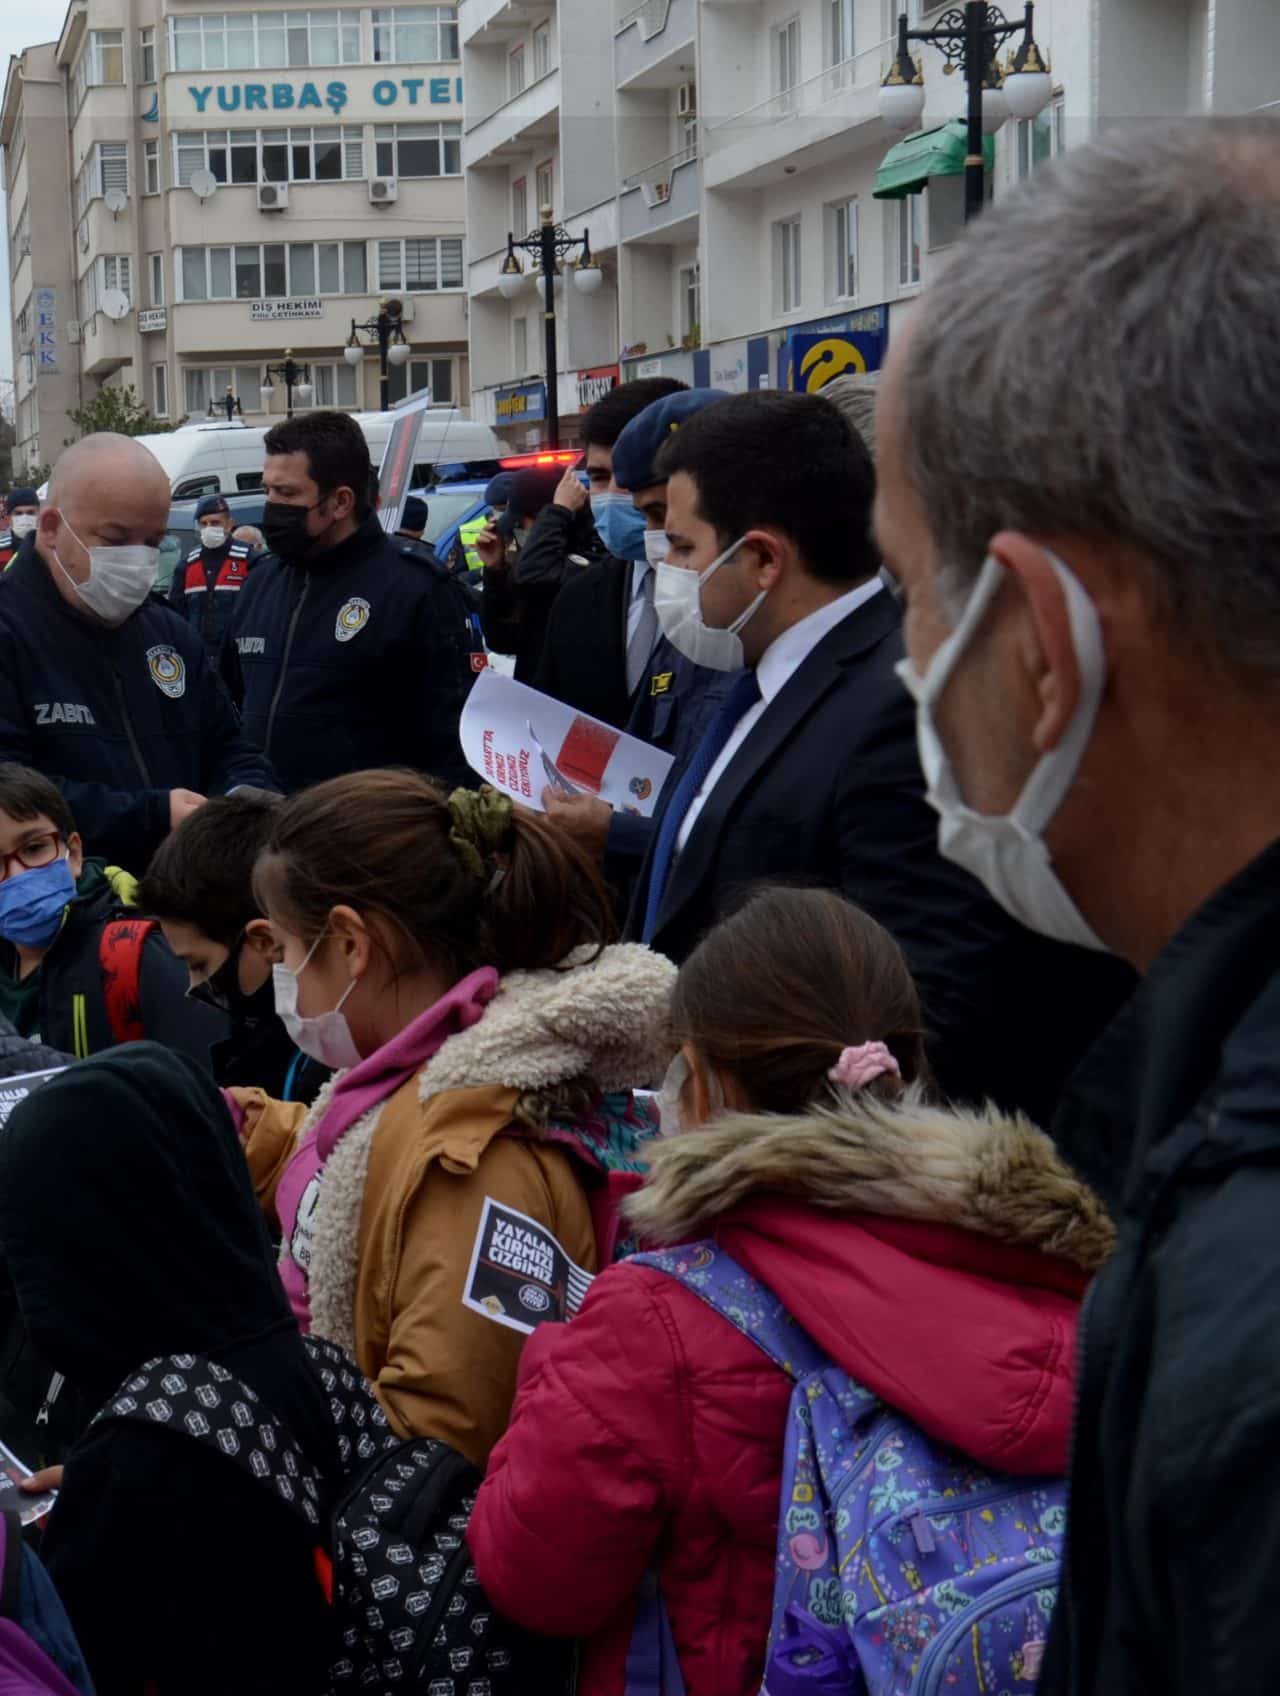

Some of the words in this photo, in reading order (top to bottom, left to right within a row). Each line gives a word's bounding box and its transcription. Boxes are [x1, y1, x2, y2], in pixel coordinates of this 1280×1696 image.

[187, 80, 349, 115] YURBAŞ
[276, 299, 322, 311] HEKİMİ
[491, 1231, 554, 1273] KIRMIZI
[495, 1218, 554, 1259] YAYALAR
